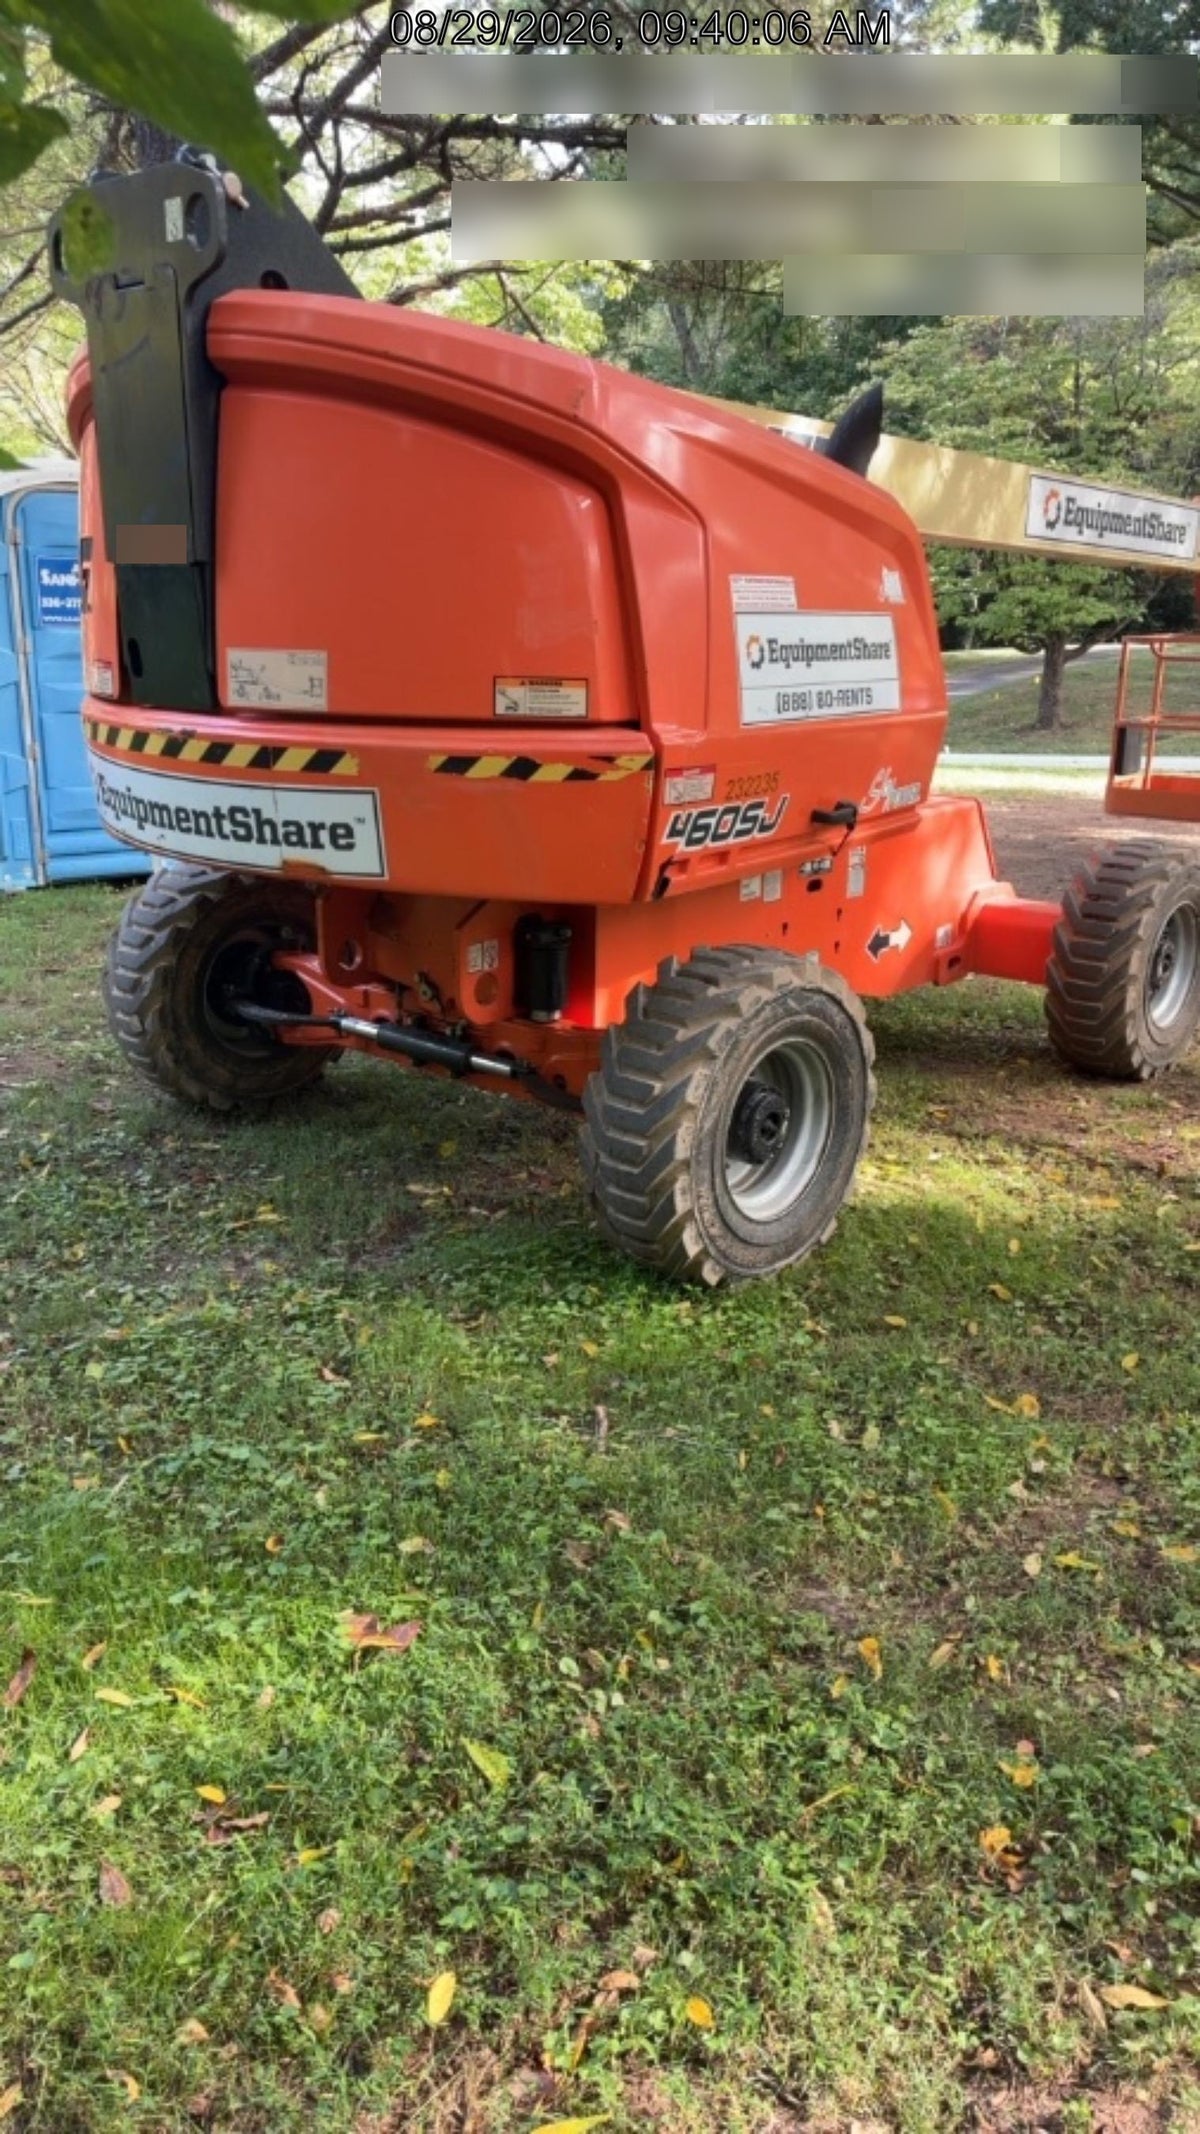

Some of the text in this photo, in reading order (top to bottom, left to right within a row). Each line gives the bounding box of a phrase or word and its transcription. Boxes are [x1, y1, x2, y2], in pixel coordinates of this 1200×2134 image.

[1063, 496, 1187, 545] EquipmentShare
[766, 637, 891, 669] EquipmentShare
[775, 691, 812, 714] (888)
[664, 794, 789, 850] 460SJ
